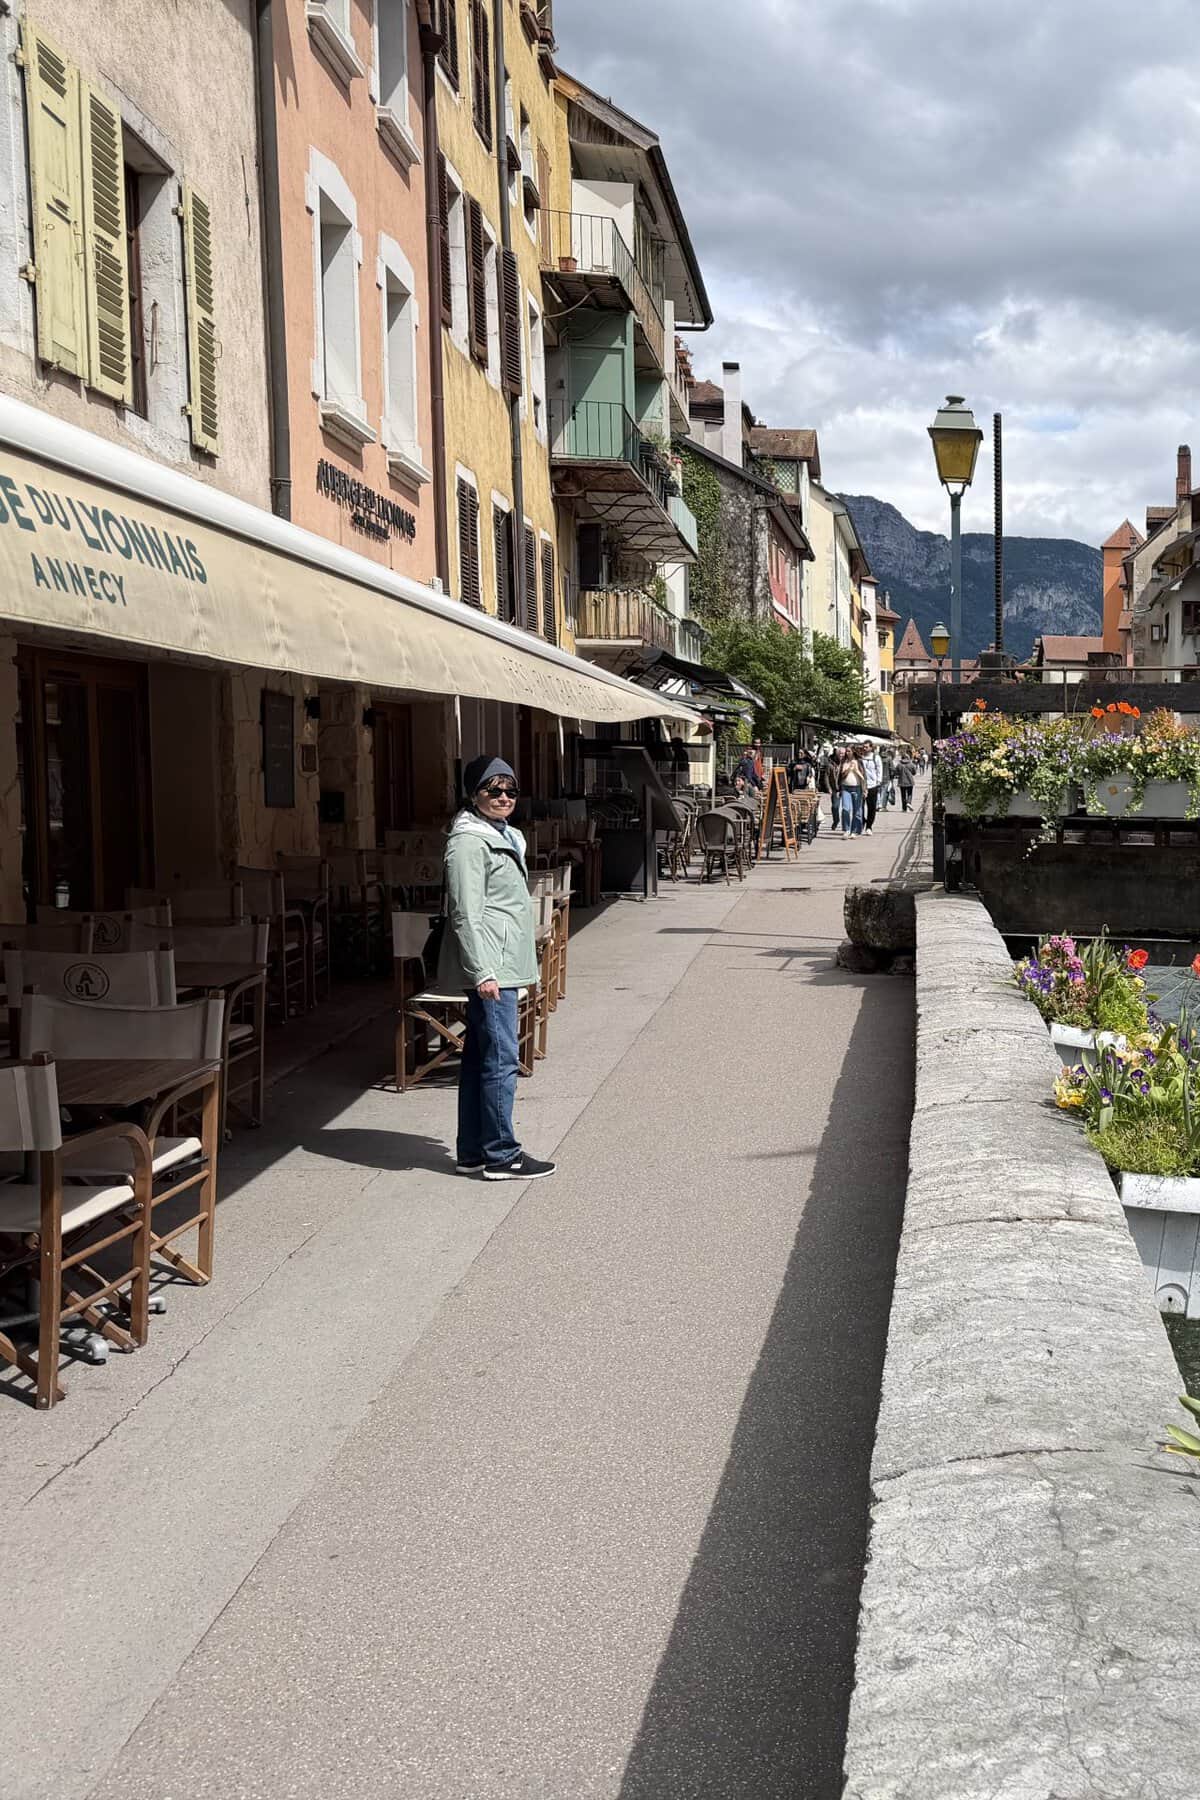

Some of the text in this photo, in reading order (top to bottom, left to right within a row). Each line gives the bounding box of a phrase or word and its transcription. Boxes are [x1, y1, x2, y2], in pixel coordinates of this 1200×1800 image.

[24, 483, 71, 532] DU
[66, 496, 208, 585] LYONNAIS
[317, 458, 365, 508] AUBERGE
[376, 494, 416, 539] LYONNAIS
[30, 551, 127, 607] ANNECY
